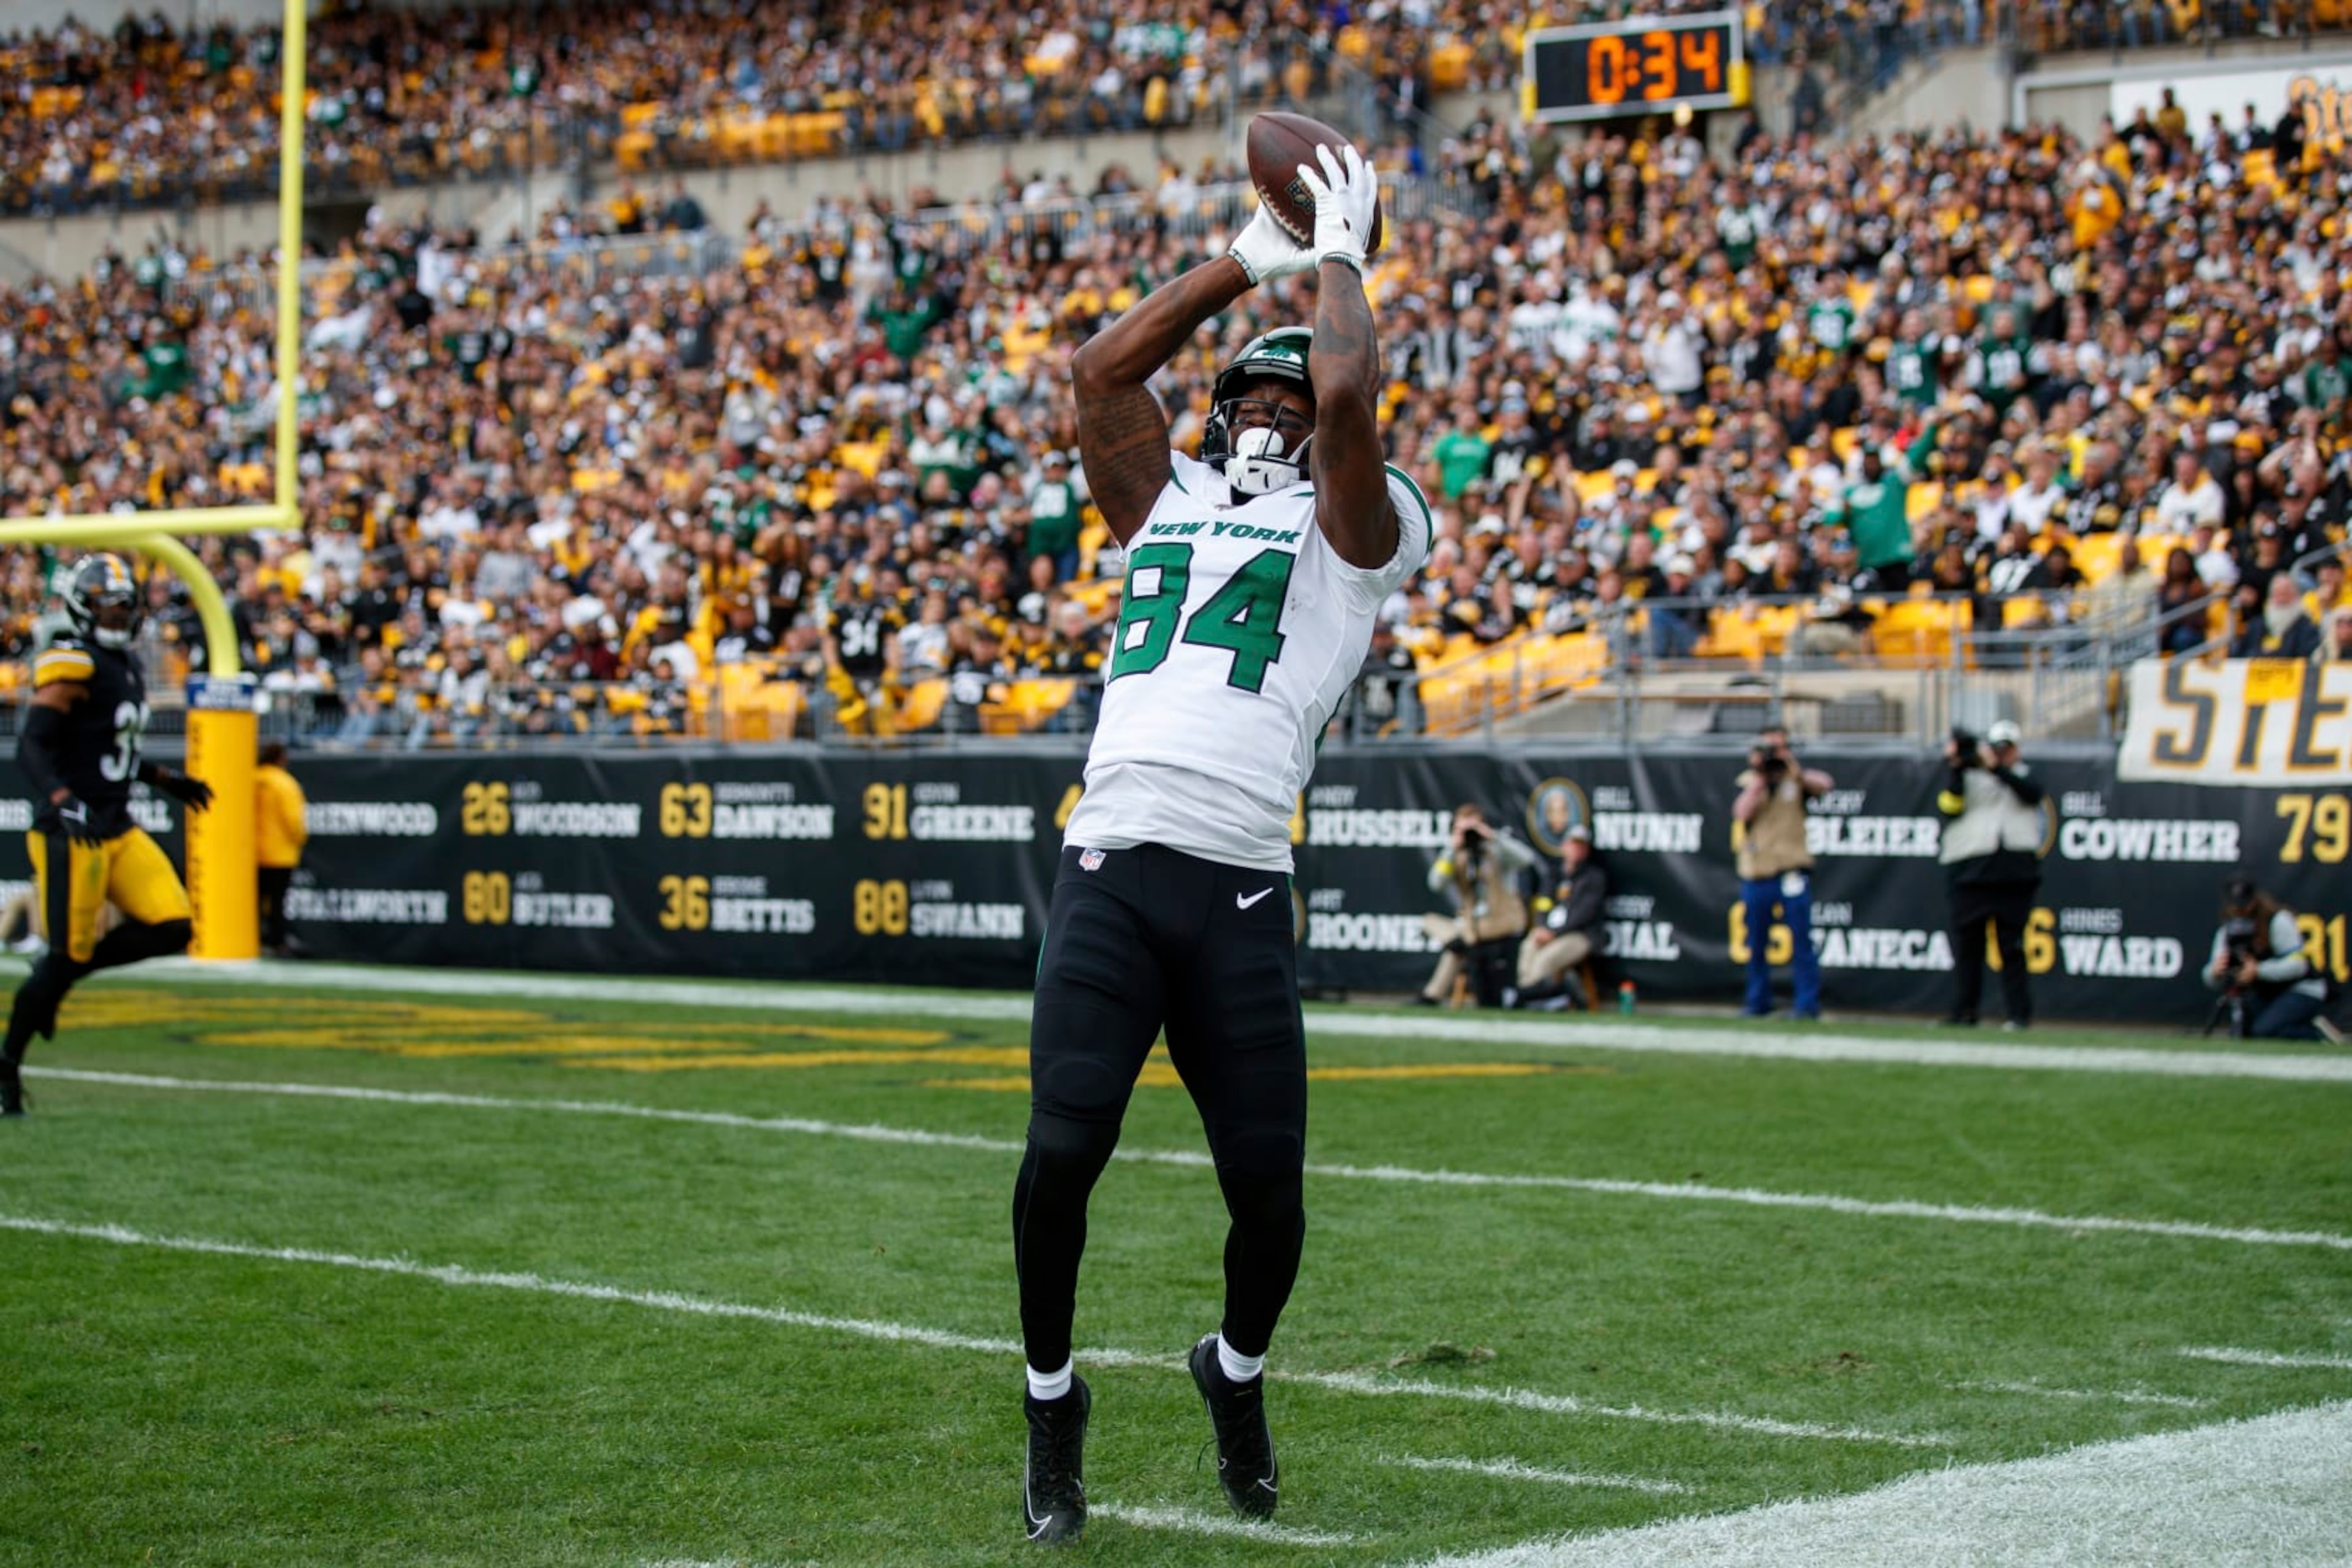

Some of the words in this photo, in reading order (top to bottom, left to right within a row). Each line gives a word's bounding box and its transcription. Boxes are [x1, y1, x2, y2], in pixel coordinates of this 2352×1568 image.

[1587, 30, 1719, 105] 0:34
[1211, 521, 1302, 544] YORK
[1107, 543, 1297, 693] 84
[462, 781, 510, 835] 26
[513, 802, 641, 837] WOODSON
[659, 783, 712, 837] 63
[712, 805, 834, 838] DAWSON
[864, 783, 908, 839] 91
[910, 805, 1035, 840] GREENE
[1594, 813, 1703, 852] NUNN
[1805, 816, 1940, 857] BLEIER
[2275, 794, 2350, 862] 79
[2059, 818, 2240, 862] COWHER
[658, 875, 709, 930] 36
[710, 899, 815, 933] BETTIS
[854, 880, 908, 936] 88
[910, 903, 1025, 939] SWANN
[1810, 901, 1853, 926] LAN
[1307, 913, 1442, 952] ROONE
[2059, 934, 2183, 977] WARD
